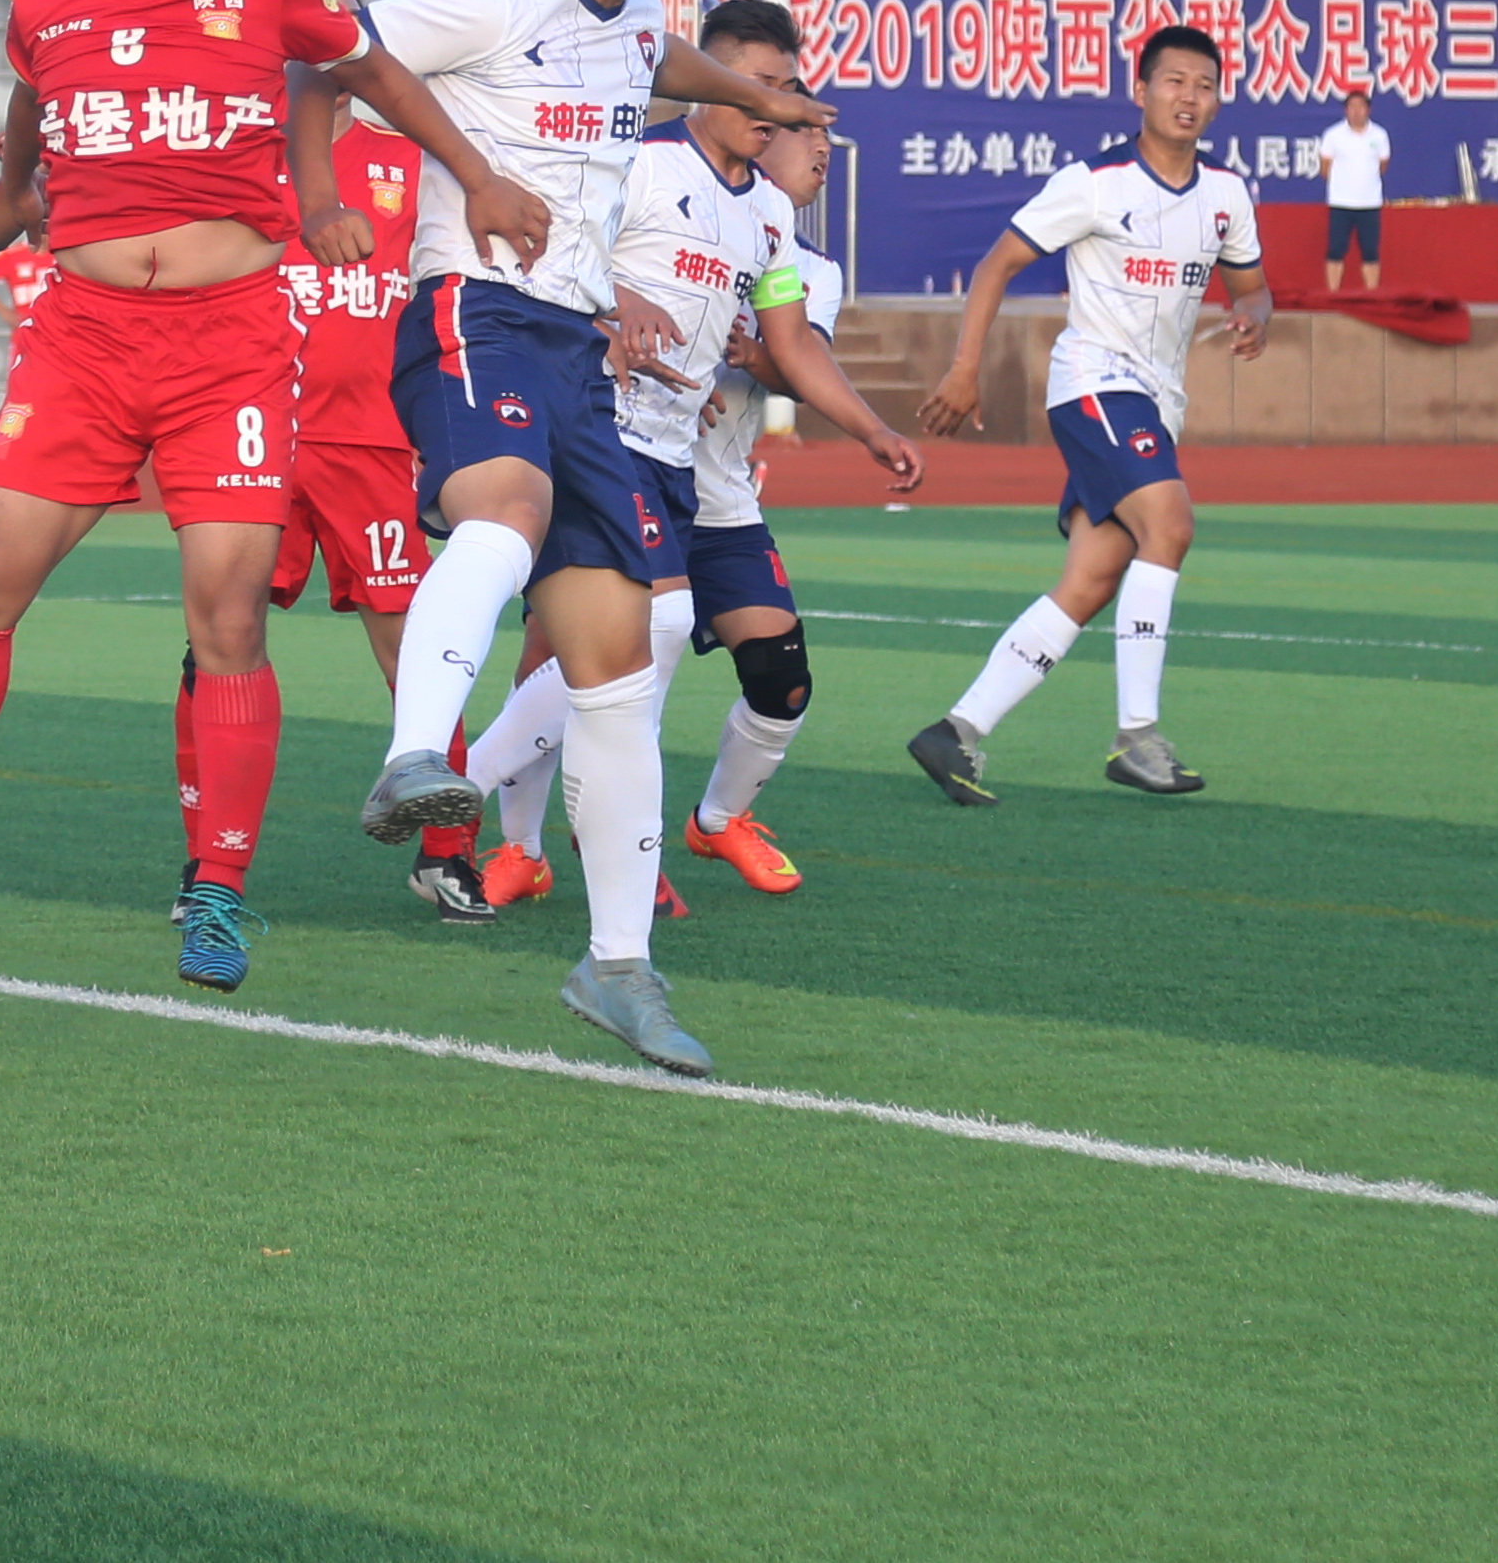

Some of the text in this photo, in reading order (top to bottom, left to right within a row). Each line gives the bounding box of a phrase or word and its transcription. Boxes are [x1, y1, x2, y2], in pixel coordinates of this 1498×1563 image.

[37, 18, 93, 42] KELME
[236, 406, 266, 467] 8
[216, 474, 283, 488] KELME
[365, 519, 410, 572] 12
[366, 573, 420, 587] KELME
